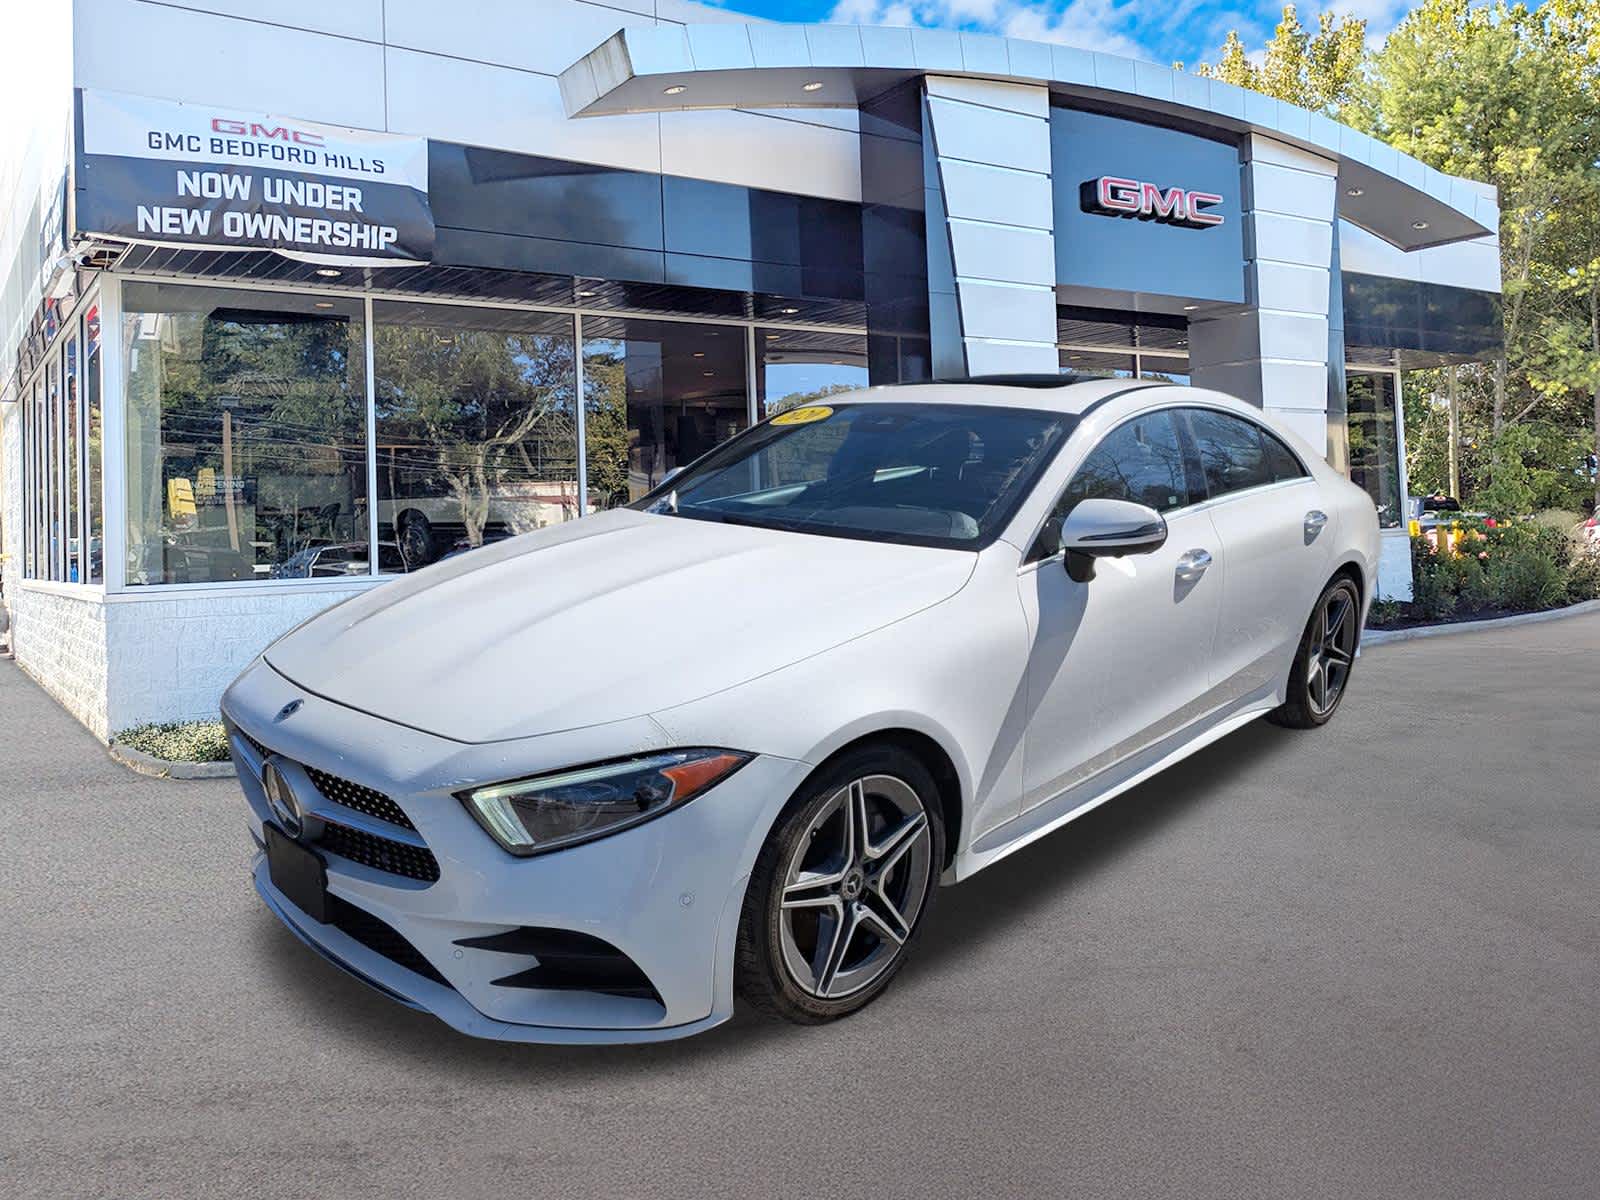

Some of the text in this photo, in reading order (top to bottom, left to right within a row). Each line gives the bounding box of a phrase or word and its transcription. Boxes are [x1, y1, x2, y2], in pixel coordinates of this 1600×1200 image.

[147, 131, 386, 174] GMC BEDFORD HILLS
[210, 117, 326, 149] GMC
[176, 170, 364, 213] NOW UNDER
[1097, 175, 1225, 225] GMC
[136, 205, 398, 250] NEW OWNERSHIP
